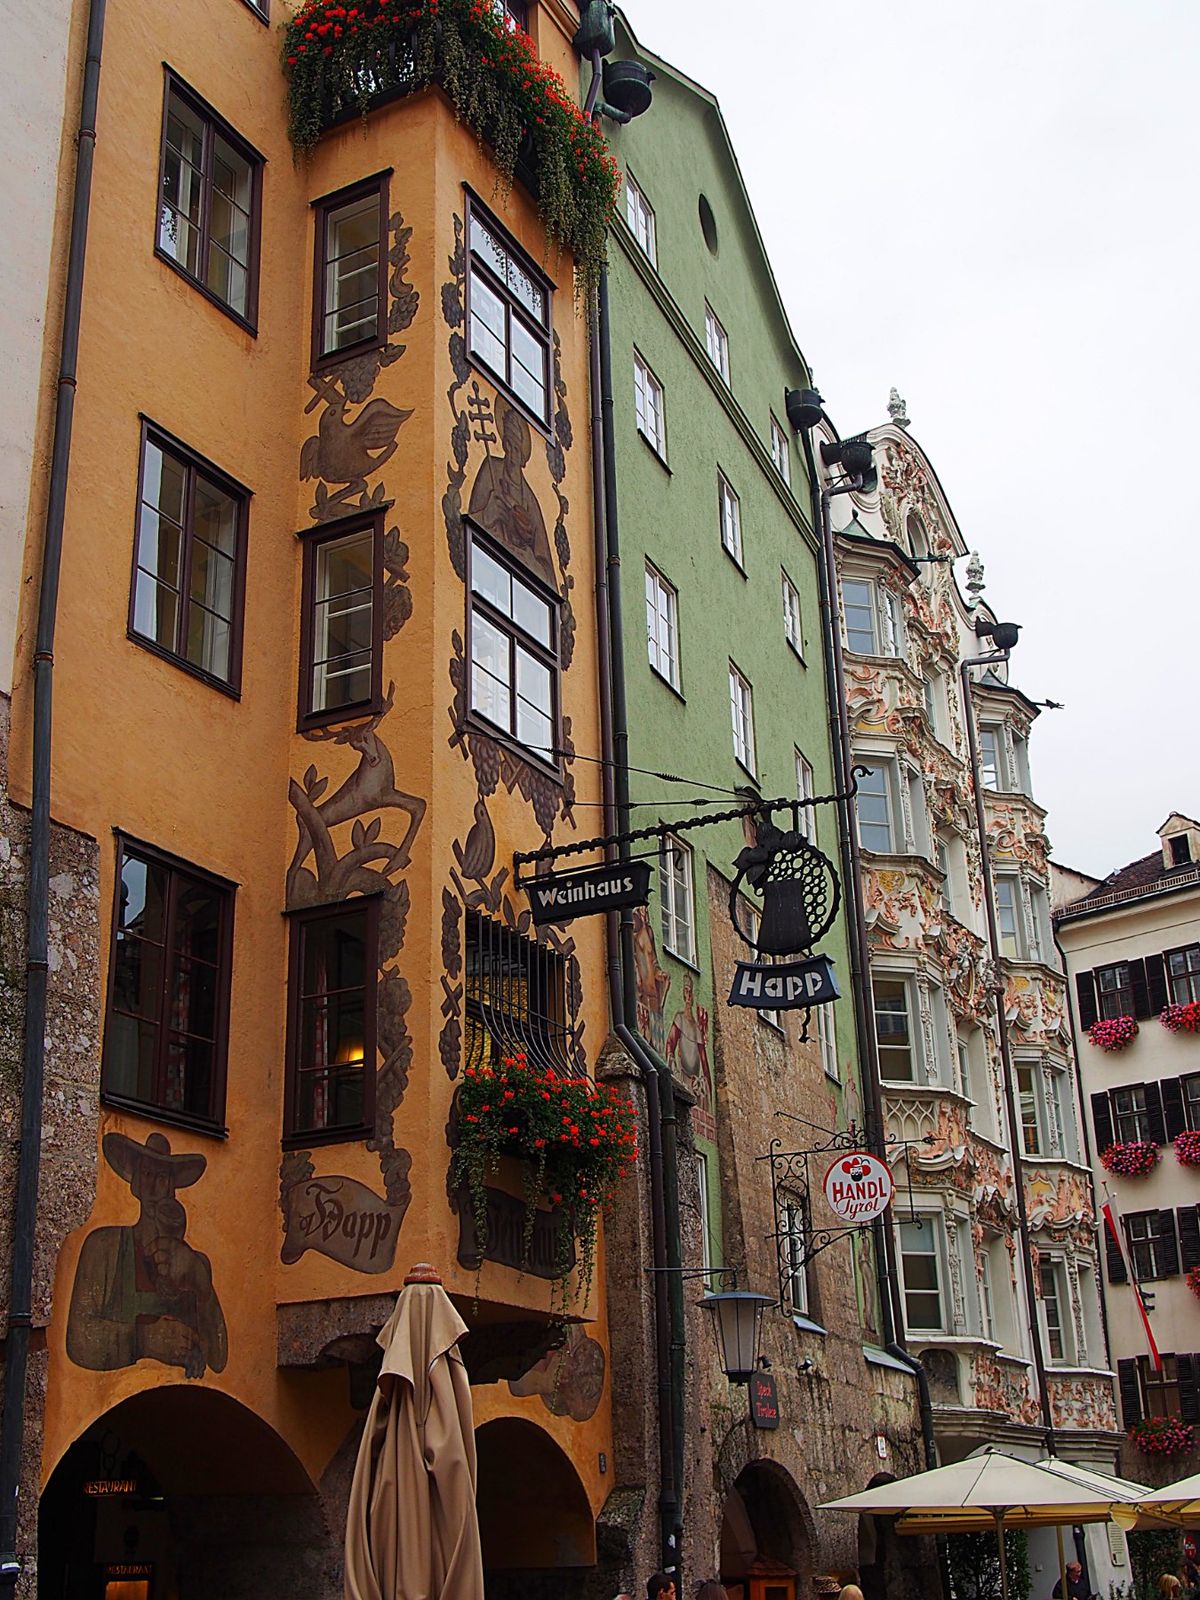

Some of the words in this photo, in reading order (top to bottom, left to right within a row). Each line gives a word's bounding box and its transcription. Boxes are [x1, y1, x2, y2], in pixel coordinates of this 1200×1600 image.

[537, 877, 634, 907] Weinhaus
[739, 970, 823, 1001] Happ
[832, 1177, 887, 1202] HANDL
[299, 1180, 392, 1260] Happ
[836, 1197, 880, 1220] Tyrol
[84, 1480, 137, 1494] RESTAURANT
